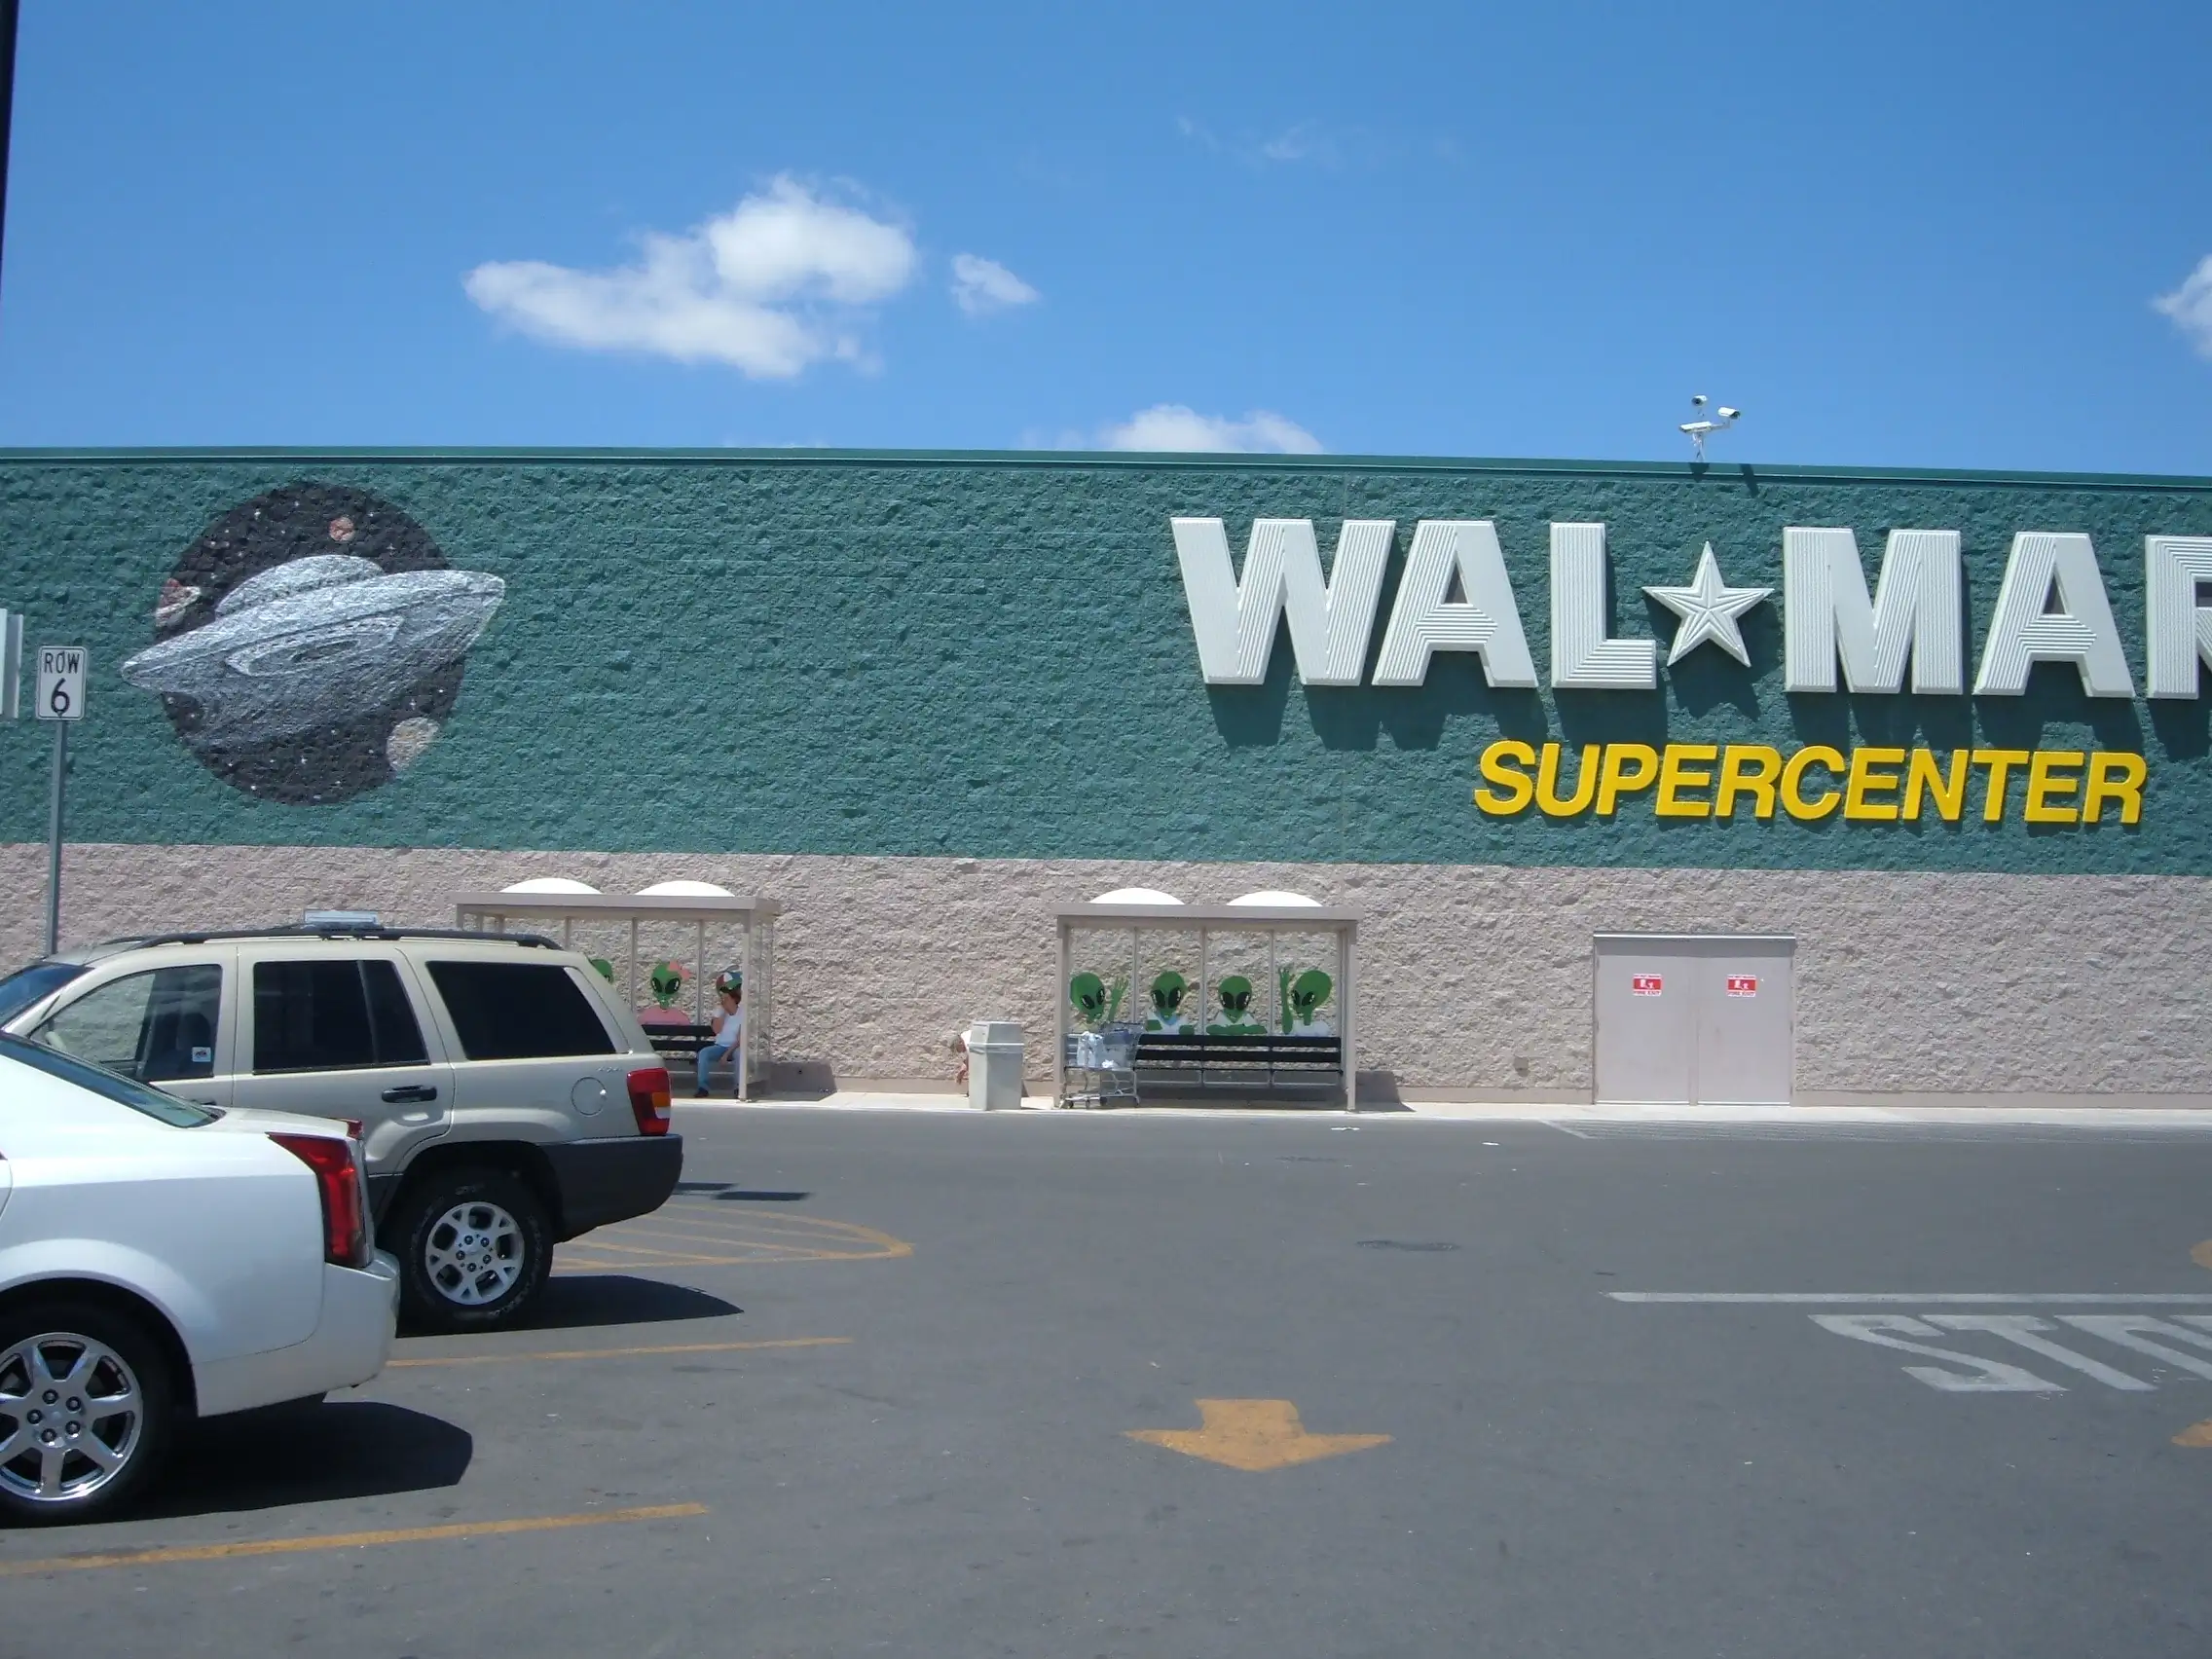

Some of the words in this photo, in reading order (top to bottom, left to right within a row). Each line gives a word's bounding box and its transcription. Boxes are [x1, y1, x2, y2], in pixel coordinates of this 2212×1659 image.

[1171, 516, 1657, 689] WAL
[44, 651, 80, 674] ROW
[51, 677, 70, 714] 6
[1474, 740, 2147, 825] SUPERCENTER
[1807, 1314, 2212, 1391] STO
